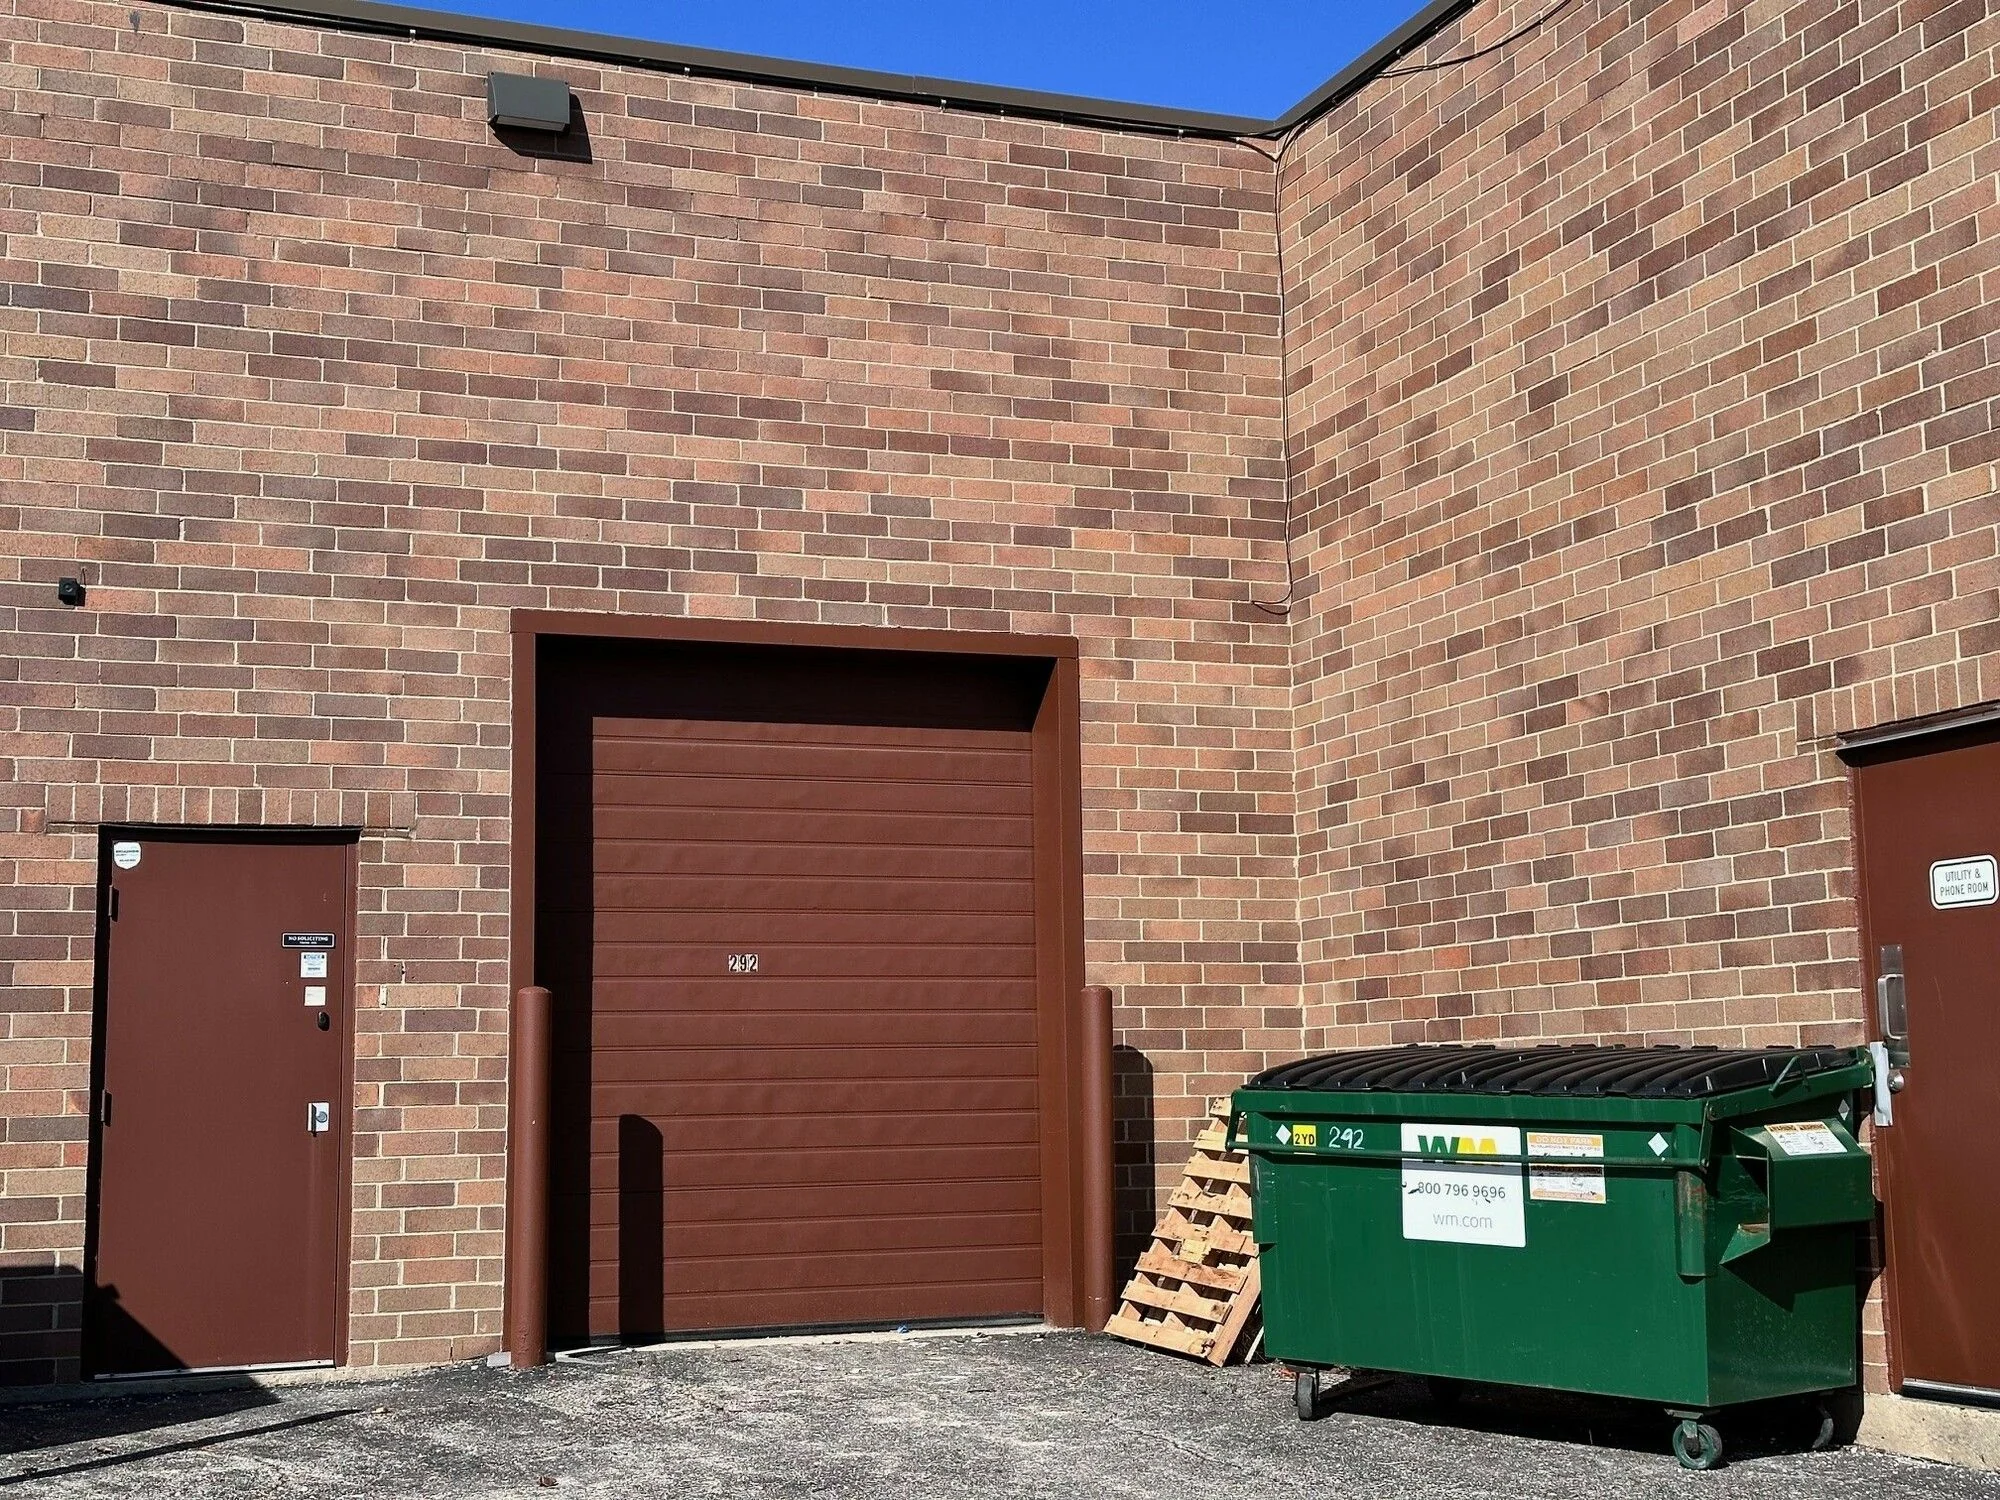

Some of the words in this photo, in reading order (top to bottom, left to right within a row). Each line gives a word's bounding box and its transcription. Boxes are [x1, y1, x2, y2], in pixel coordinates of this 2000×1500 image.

[1945, 870, 1971, 882] UTILITY
[1975, 868, 1981, 878] &
[1940, 884, 1965, 896] PHONE
[1967, 882, 1988, 894] ROOM
[729, 954, 758, 972] 292
[1294, 1133, 1315, 1145] 2YD
[1328, 1126, 1365, 1150] 292
[1417, 1135, 1503, 1166] WM
[1417, 1181, 1441, 1195] 800
[1444, 1184, 1469, 1197] 796
[1472, 1185, 1506, 1199] 9696
[1432, 1213, 1493, 1229] wm.com
